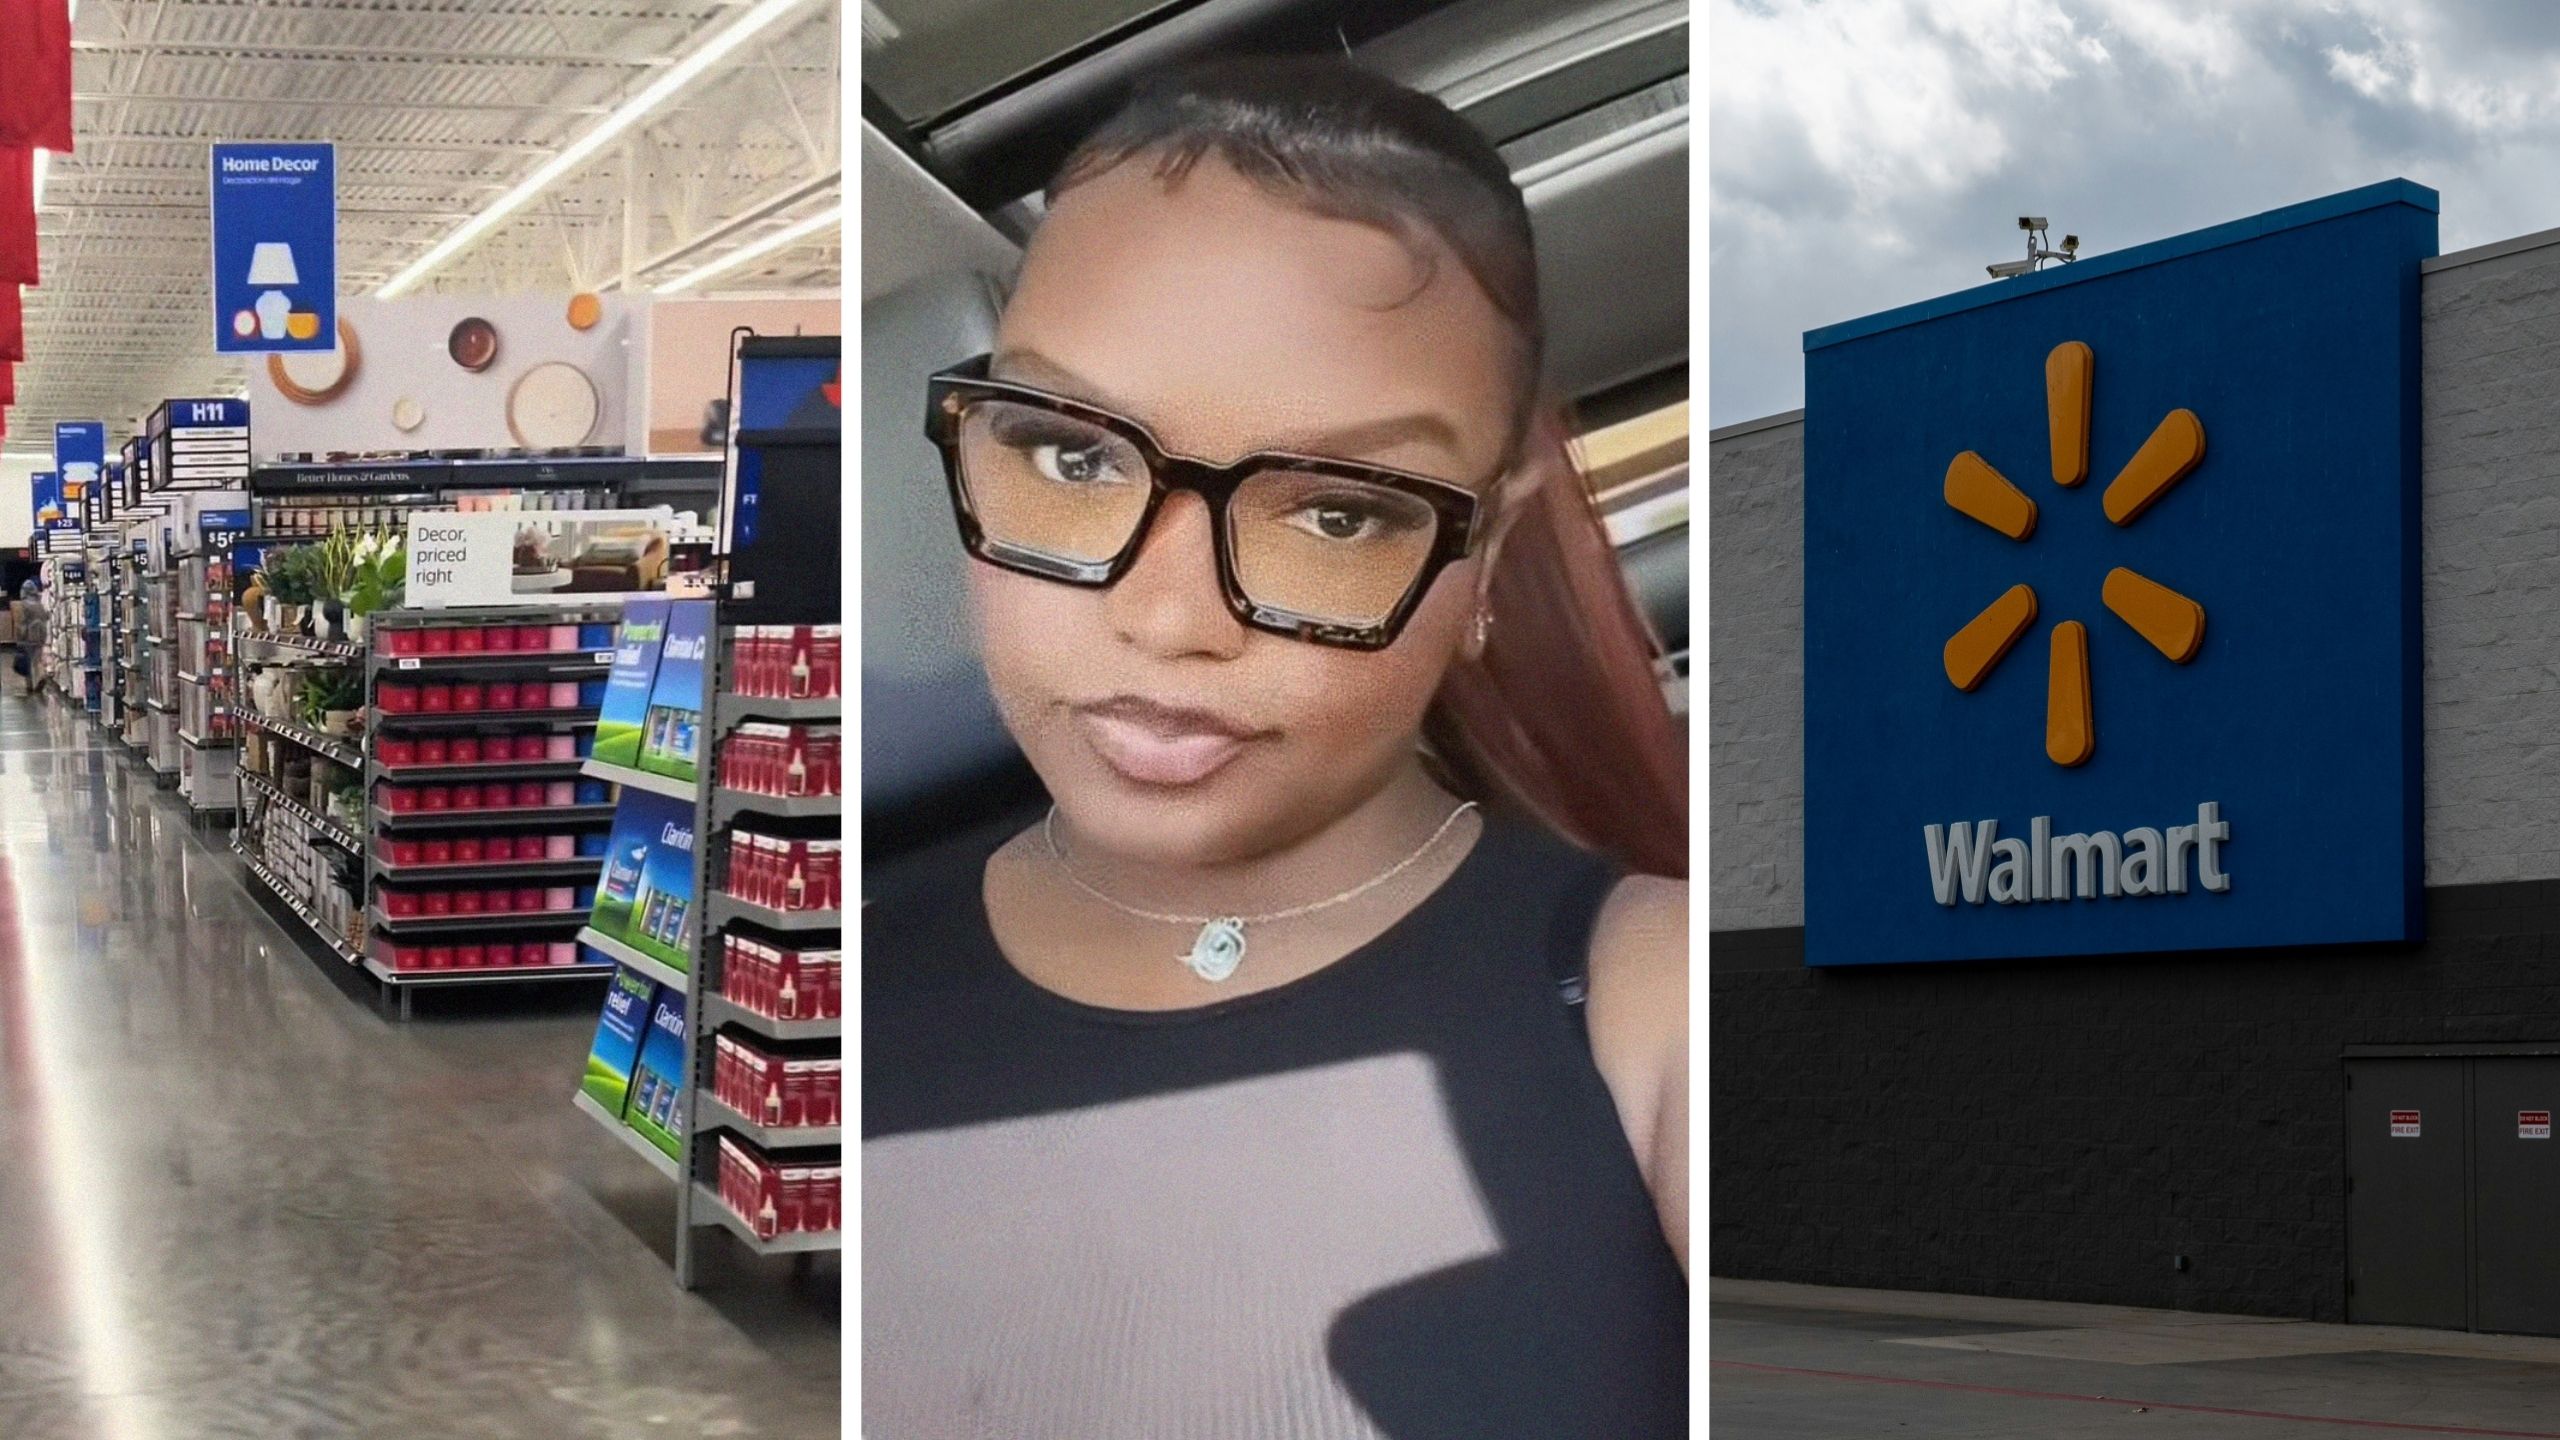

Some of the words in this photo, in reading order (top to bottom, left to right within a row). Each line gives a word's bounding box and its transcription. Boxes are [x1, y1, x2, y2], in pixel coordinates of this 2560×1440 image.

[222, 157, 270, 172] Home
[272, 156, 319, 171] Decor
[192, 403, 224, 422] H11
[297, 473, 326, 483] Better
[327, 472, 358, 483] Homes
[360, 472, 369, 482] &
[370, 471, 410, 482] Gardens
[418, 527, 467, 543] Decor,
[417, 546, 467, 566] priced
[416, 568, 453, 587] right
[1923, 800, 2230, 907] Walmart
[607, 991, 632, 1016] relief
[654, 1002, 685, 1038] Claritin
[2391, 1126, 2405, 1134] FIRE
[2405, 1126, 2419, 1134] EXIT
[2519, 1127, 2534, 1136] FIRE
[2534, 1127, 2549, 1136] EXIT
